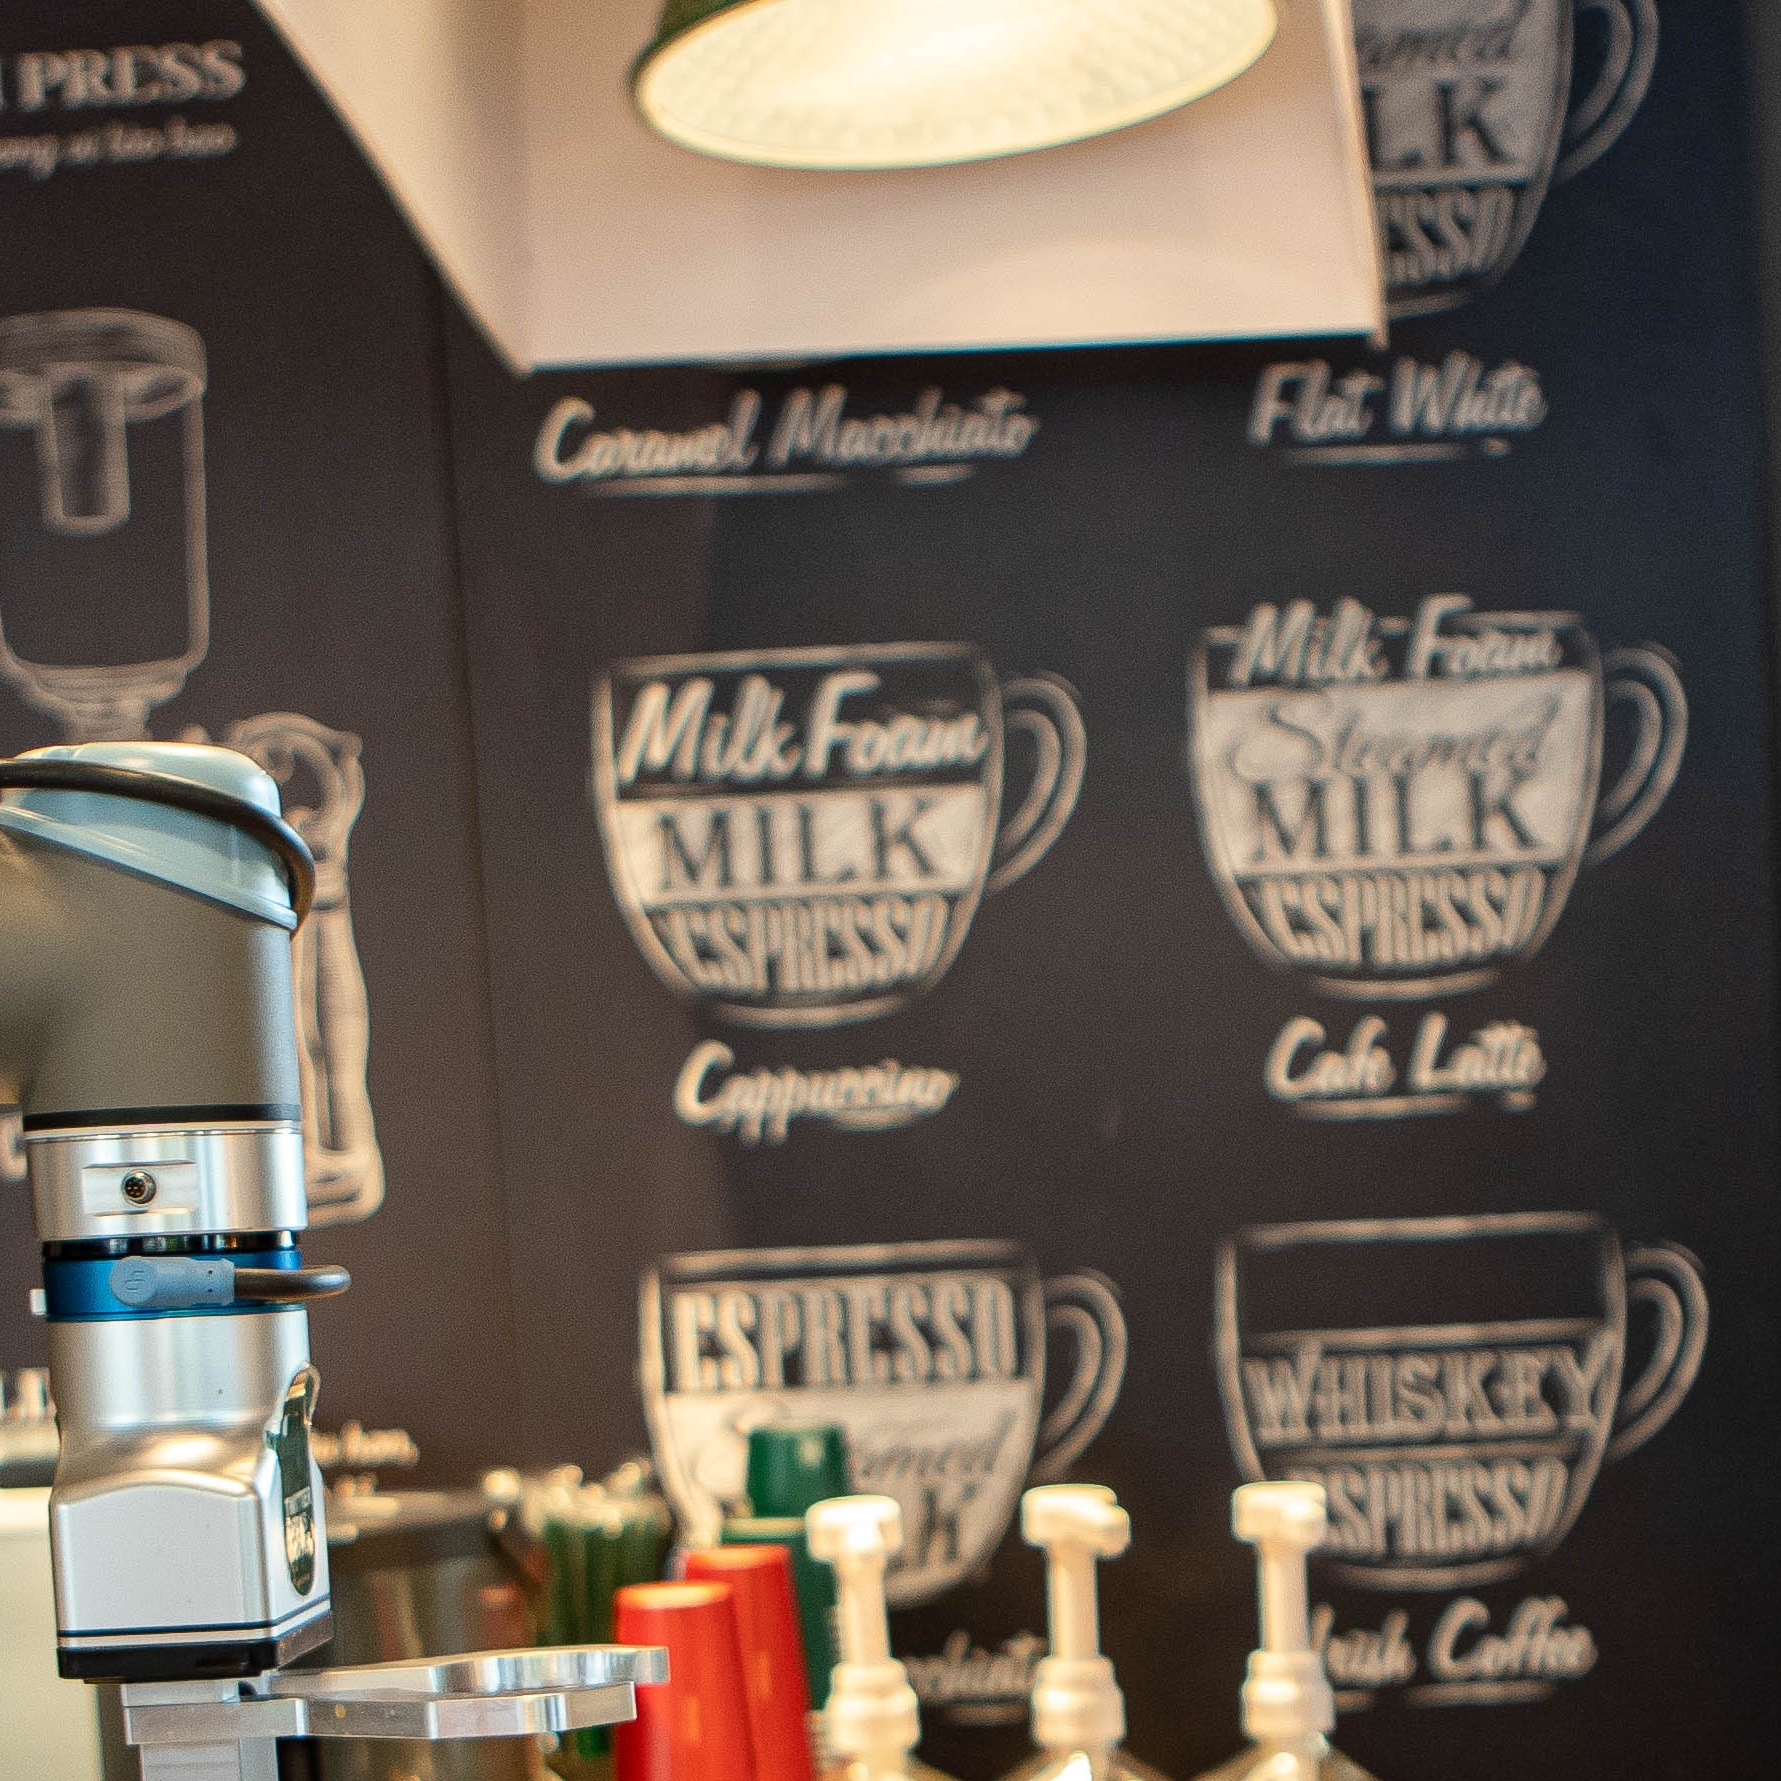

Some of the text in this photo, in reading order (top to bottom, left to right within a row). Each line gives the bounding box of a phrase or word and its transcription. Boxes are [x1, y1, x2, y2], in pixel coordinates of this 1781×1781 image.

[20, 40, 246, 112] PRESS
[533, 383, 1042, 485] Caramel Macchiato
[1247, 349, 1547, 446] Flat White
[1228, 593, 1565, 687] Milk Foam
[616, 669, 990, 787] Milk Foam
[657, 792, 947, 895] MILK
[1251, 771, 1545, 862] MILK
[651, 895, 951, 997] ESPRESSO
[1249, 868, 1548, 969] ESPRESSO
[669, 1276, 1021, 1392] ESPRESSO
[1241, 1332, 1619, 1447] WHISKEY
[1426, 1594, 1600, 1681] Coffee
